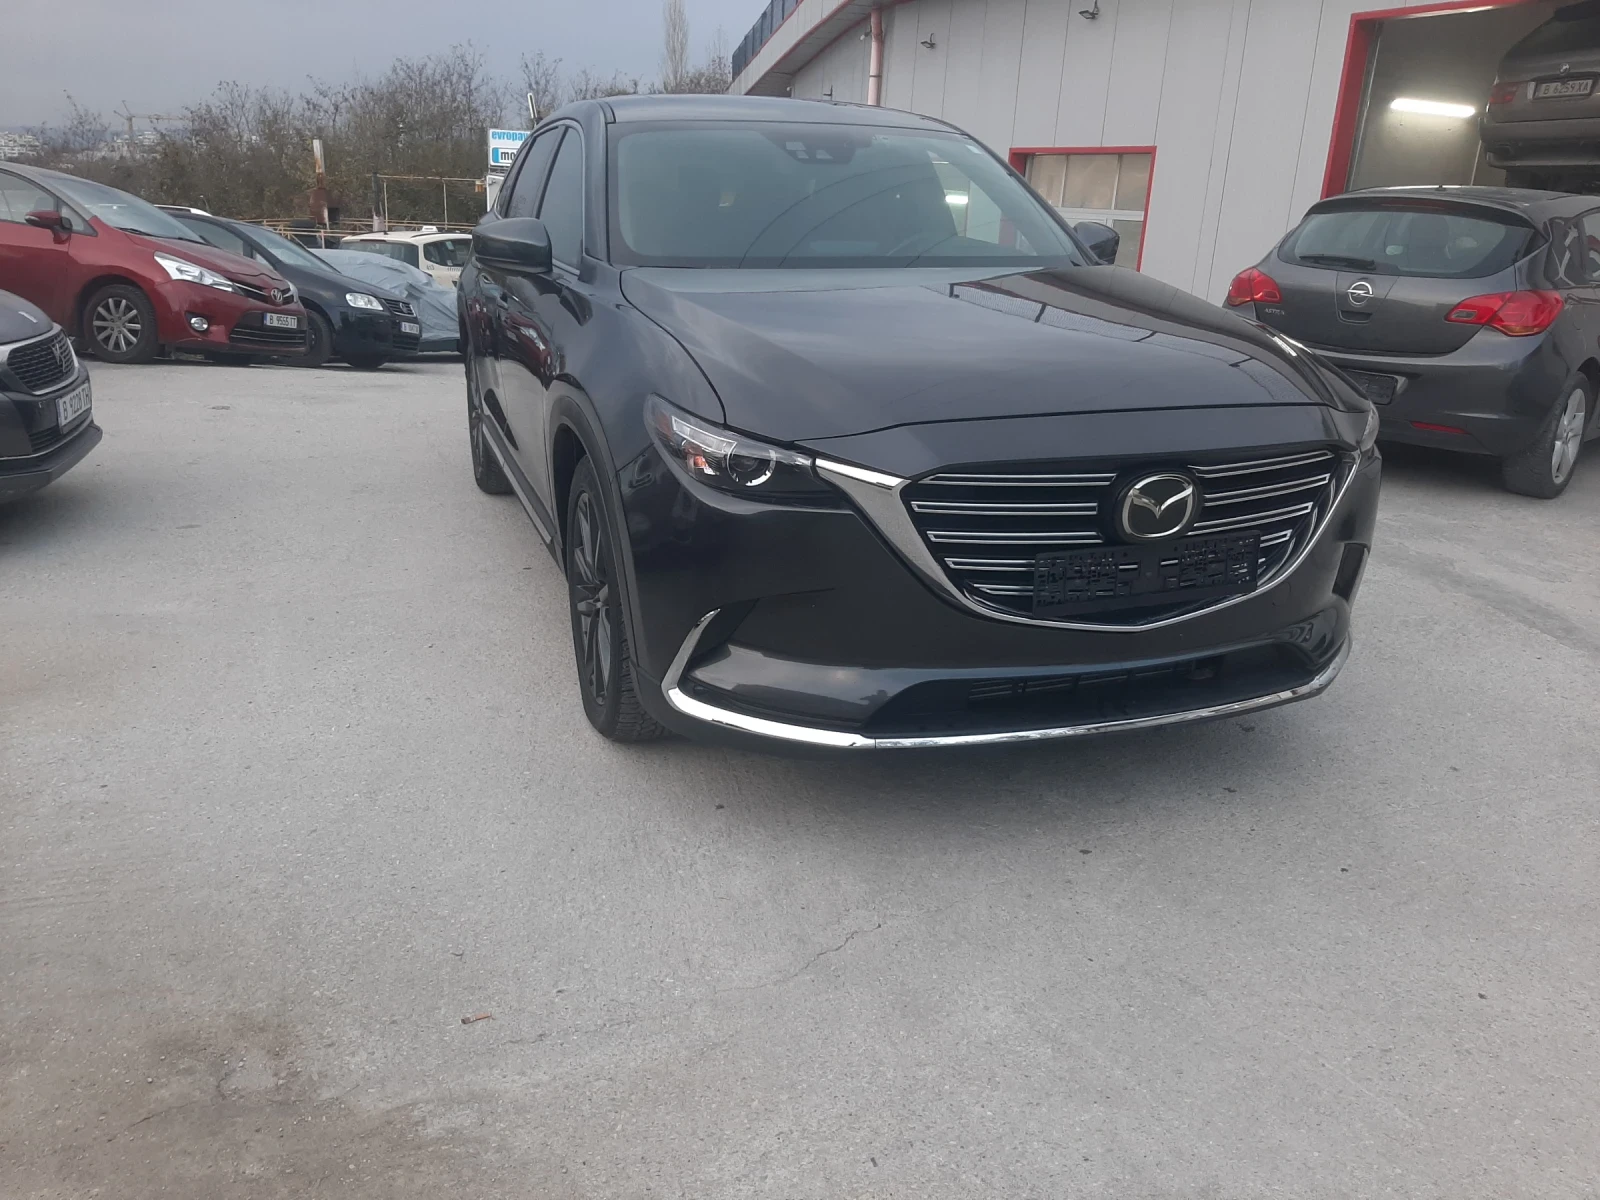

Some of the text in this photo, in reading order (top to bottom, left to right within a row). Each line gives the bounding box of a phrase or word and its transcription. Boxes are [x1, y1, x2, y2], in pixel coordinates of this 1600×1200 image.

[1543, 85, 1551, 95] B
[269, 314, 274, 325] B
[62, 400, 69, 421] B
